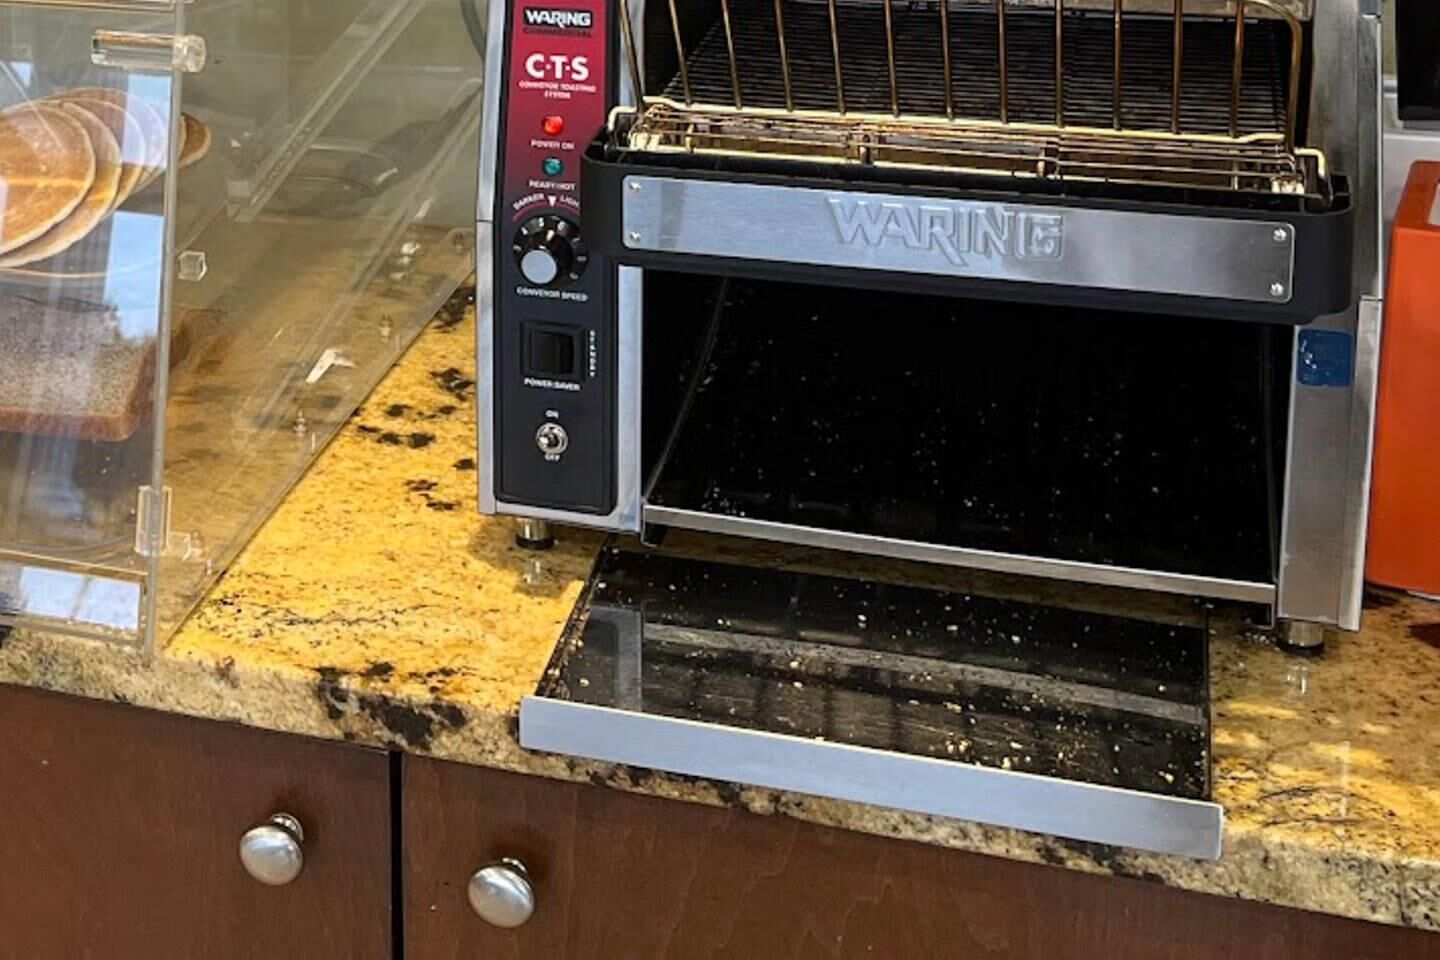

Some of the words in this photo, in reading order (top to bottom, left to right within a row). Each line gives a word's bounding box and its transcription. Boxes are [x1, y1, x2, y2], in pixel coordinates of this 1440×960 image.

[525, 9, 592, 28] WARING
[531, 139, 560, 149] POWER
[561, 142, 575, 150] ON
[560, 194, 580, 208] LIGH
[825, 197, 1064, 267] WARING
[516, 286, 560, 298] CONVEYOR
[561, 291, 589, 302] SPEED
[545, 409, 559, 419] ON
